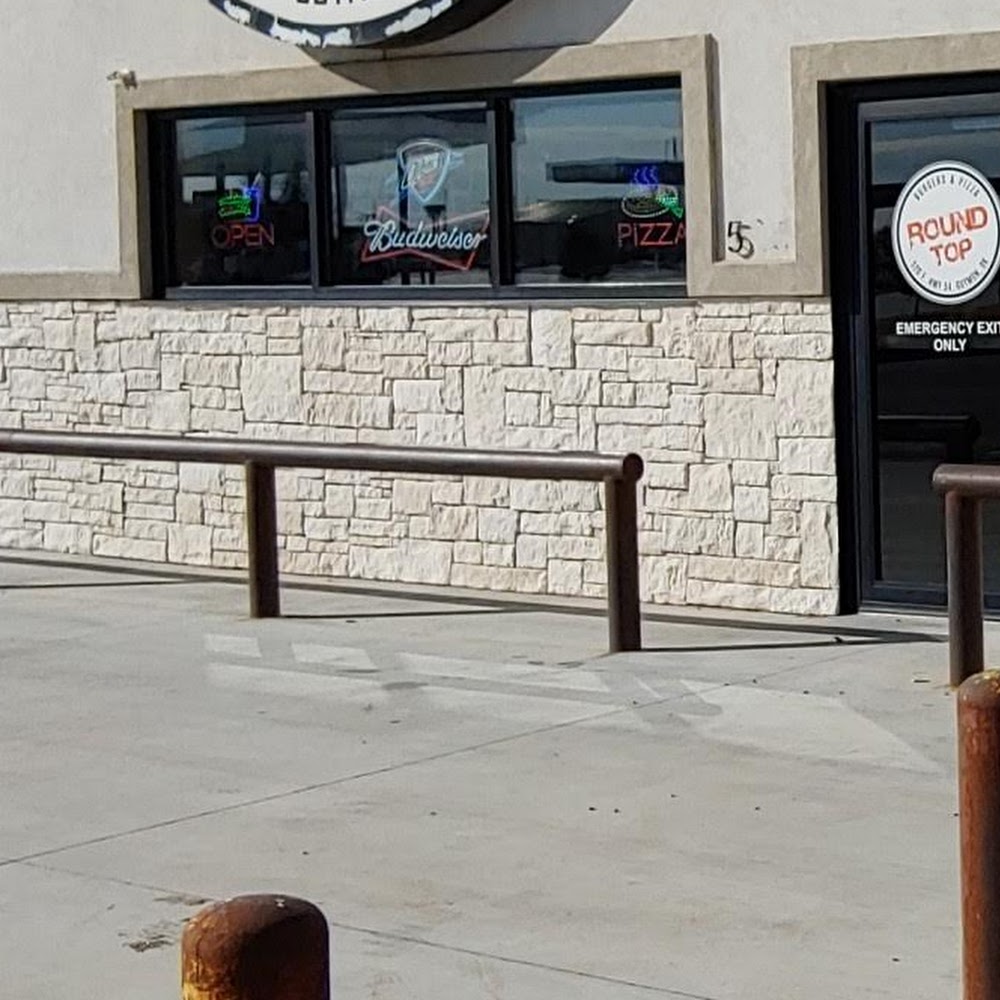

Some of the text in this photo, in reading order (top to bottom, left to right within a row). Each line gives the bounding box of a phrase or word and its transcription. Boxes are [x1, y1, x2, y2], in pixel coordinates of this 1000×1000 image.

[211, 223, 275, 249] OPEN
[364, 220, 487, 252] Budweiser
[617, 223, 686, 247] PIZZA
[907, 206, 988, 250] ROUND
[929, 238, 973, 266] TOP
[896, 321, 974, 335] EMERGENCY
[933, 338, 967, 351] ONLY
